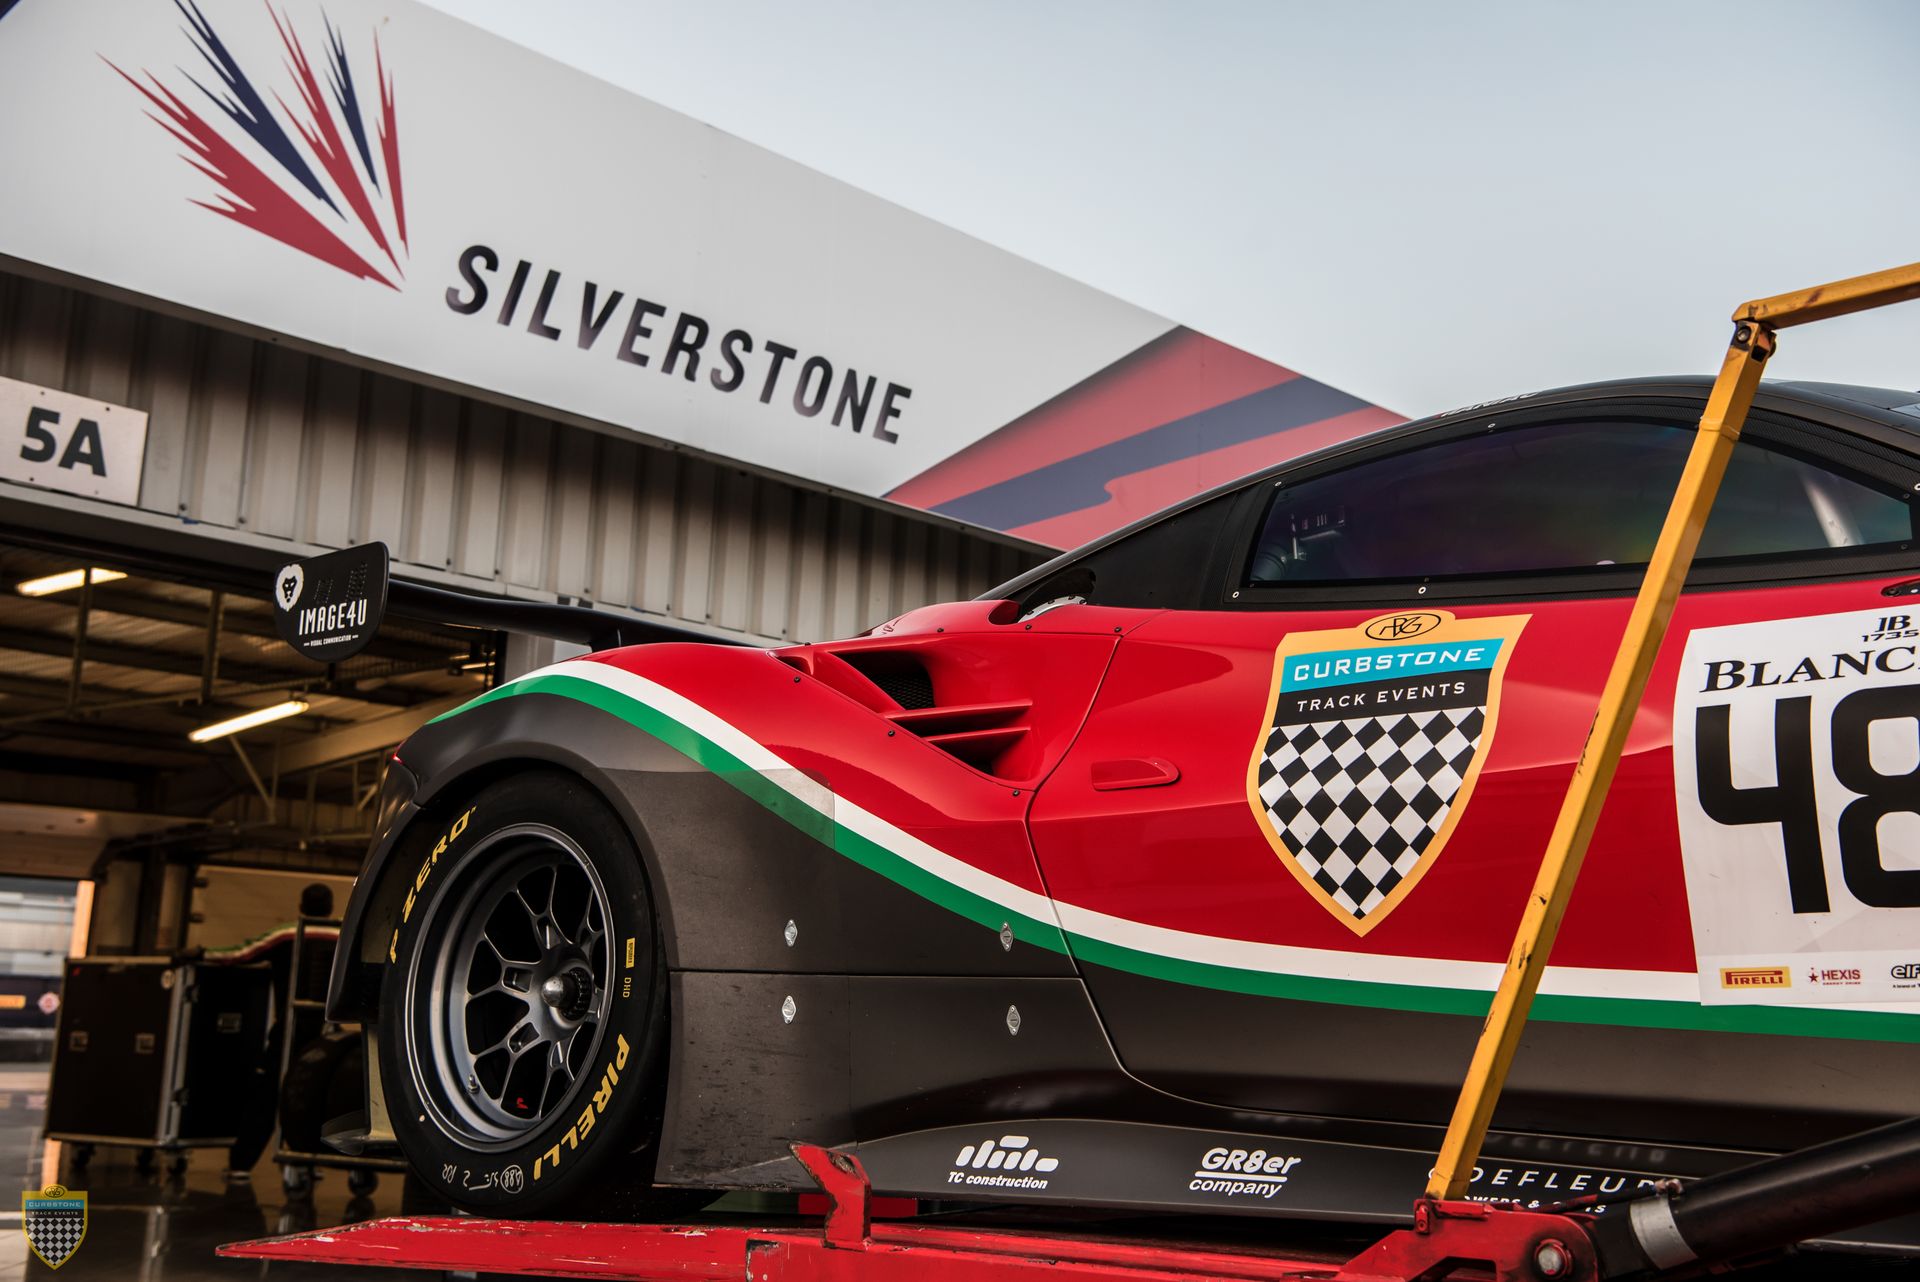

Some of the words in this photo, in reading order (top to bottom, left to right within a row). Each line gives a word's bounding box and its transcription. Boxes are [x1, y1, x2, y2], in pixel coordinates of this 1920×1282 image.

[445, 245, 912, 444] SILVERSTONE
[20, 406, 107, 477] 5A
[299, 599, 367, 635] IMAGE4U
[1862, 629, 1919, 642] 1735
[1294, 647, 1485, 682] CURBSTONE
[1699, 646, 1920, 693] BLANC
[1297, 693, 1366, 712] TRACK
[1377, 681, 1466, 703] EVENTS
[402, 808, 472, 923] ZERO
[1725, 970, 1783, 985] PIRELLI
[1821, 969, 1861, 980] HEXIS
[533, 1034, 630, 1181] PIRELLI
[1201, 1147, 1301, 1174] GR8er
[948, 1171, 965, 1183] TC
[966, 1175, 1048, 1189] construction
[1189, 1179, 1282, 1198] company
